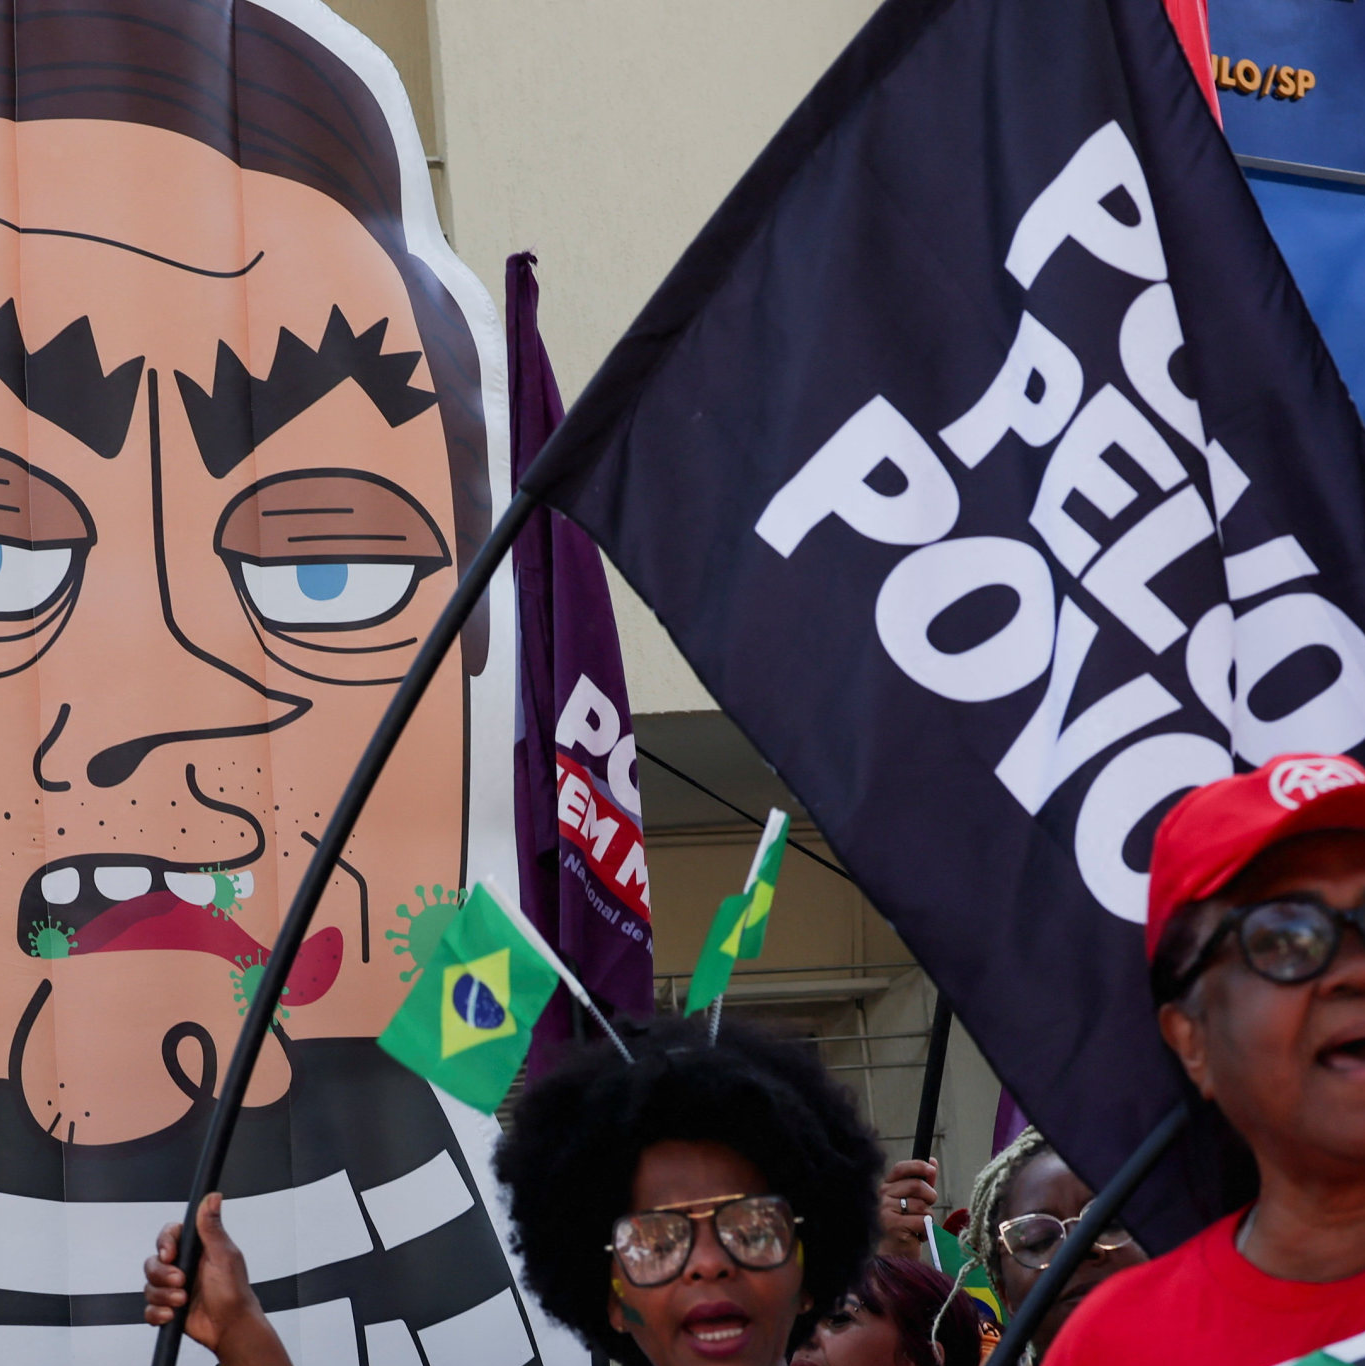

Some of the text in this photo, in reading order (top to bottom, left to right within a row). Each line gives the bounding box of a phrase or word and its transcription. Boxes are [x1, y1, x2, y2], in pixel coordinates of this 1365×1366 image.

[754, 393, 1235, 925] POVO
[556, 762, 619, 862] EM
[564, 852, 644, 942] Naional de
